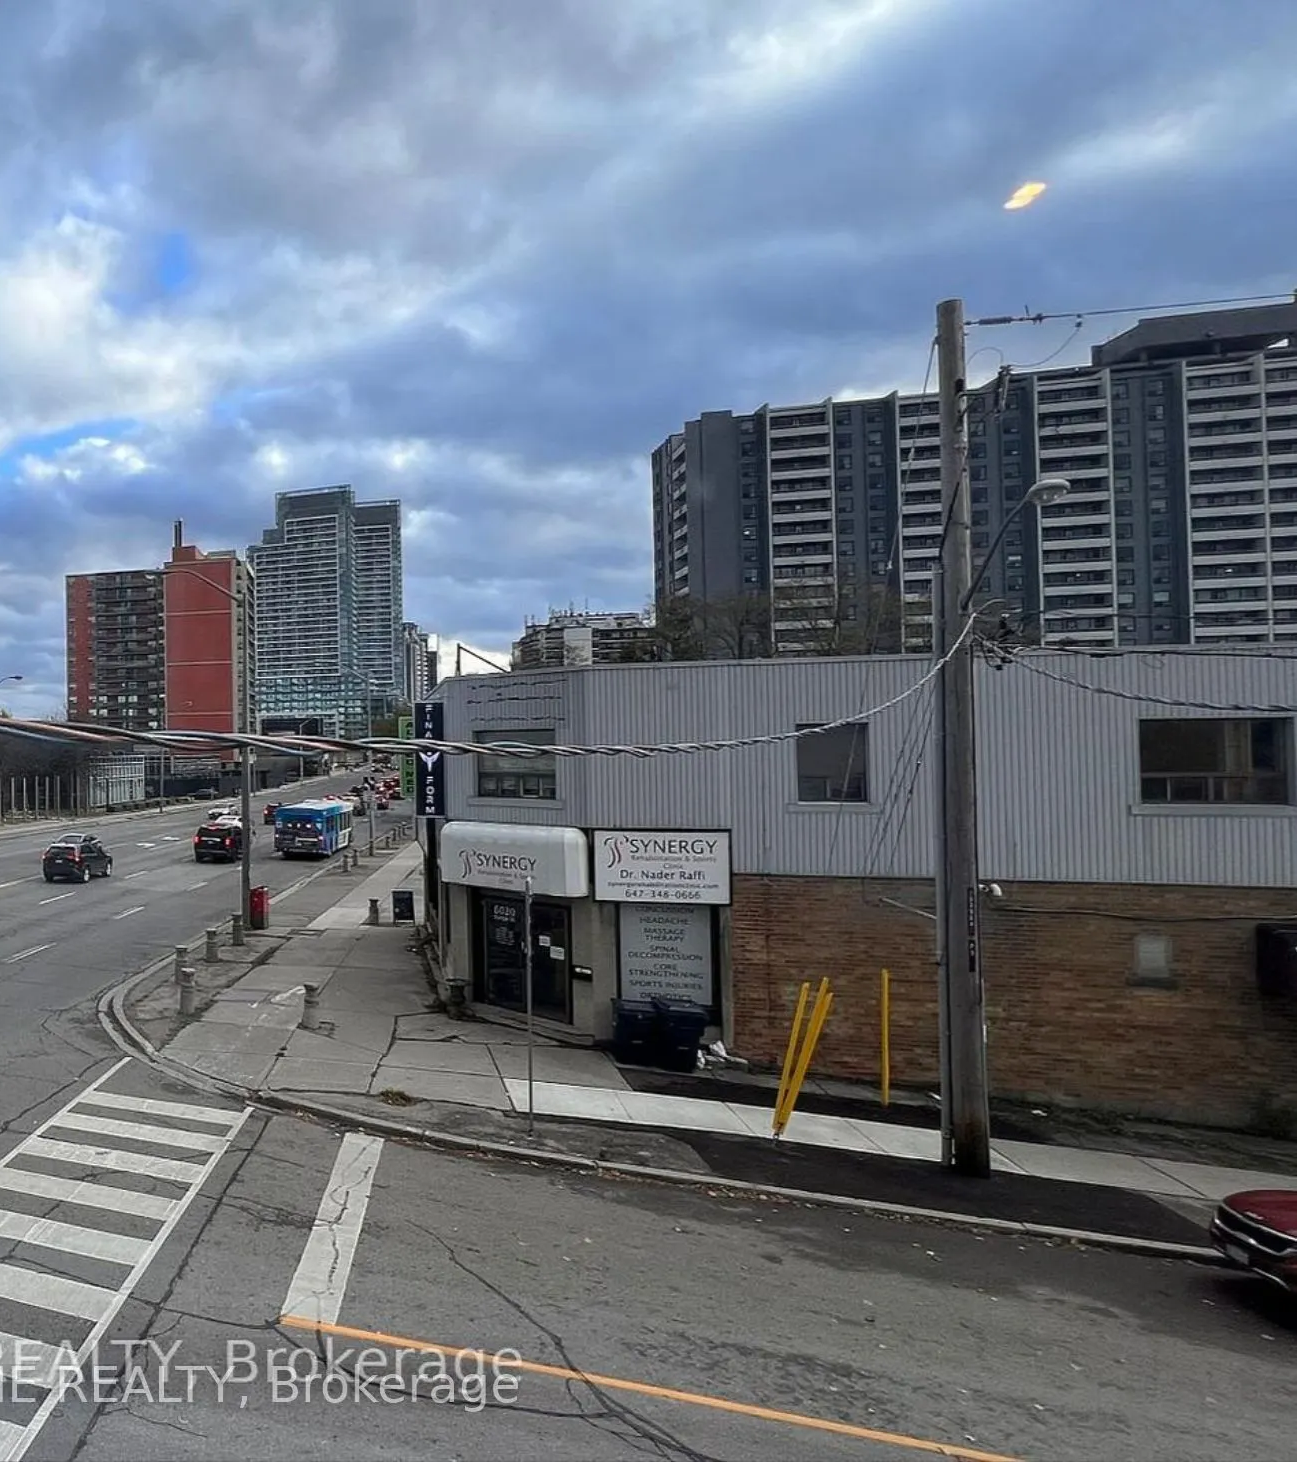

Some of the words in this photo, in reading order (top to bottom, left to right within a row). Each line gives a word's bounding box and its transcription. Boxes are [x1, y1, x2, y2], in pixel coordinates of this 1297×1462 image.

[425, 776, 436, 814] FORM
[630, 839, 718, 854] SYNERGY
[477, 852, 537, 872] SYNERGY
[620, 869, 637, 879] Dr.
[641, 870, 676, 880] Nader
[679, 871, 706, 880] Raffi
[639, 916, 691, 925] HEADACHE
[643, 927, 685, 935] MASSAGE
[650, 945, 679, 953] SPINAL
[628, 951, 703, 960] DECOMPRESSION
[629, 969, 703, 979] STRENGTHENING
[629, 979, 663, 988] SPORTS
